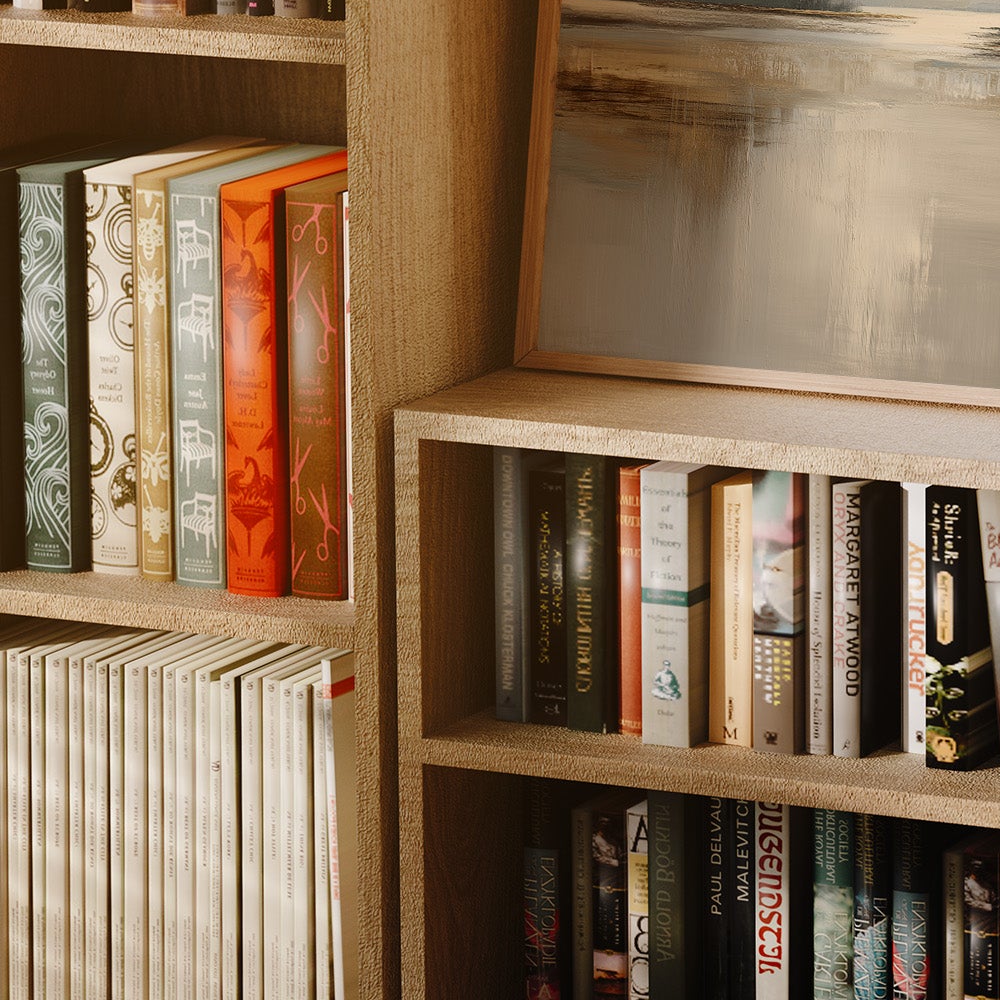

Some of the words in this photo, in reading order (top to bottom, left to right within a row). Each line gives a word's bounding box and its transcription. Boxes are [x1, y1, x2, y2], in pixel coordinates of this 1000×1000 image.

[502, 455, 513, 529] DOWNTOWN
[834, 492, 846, 543] ORYX
[502, 531, 513, 556] OWL
[650, 538, 683, 551] Theory
[846, 493, 860, 606] MARGARET
[502, 564, 513, 606] CHUCK
[834, 551, 846, 594] AND
[502, 609, 513, 690] KLOSTERMAN
[834, 601, 846, 669] CRAKE
[846, 610, 860, 697] ATWOOD
[711, 874, 723, 916] PAUL
